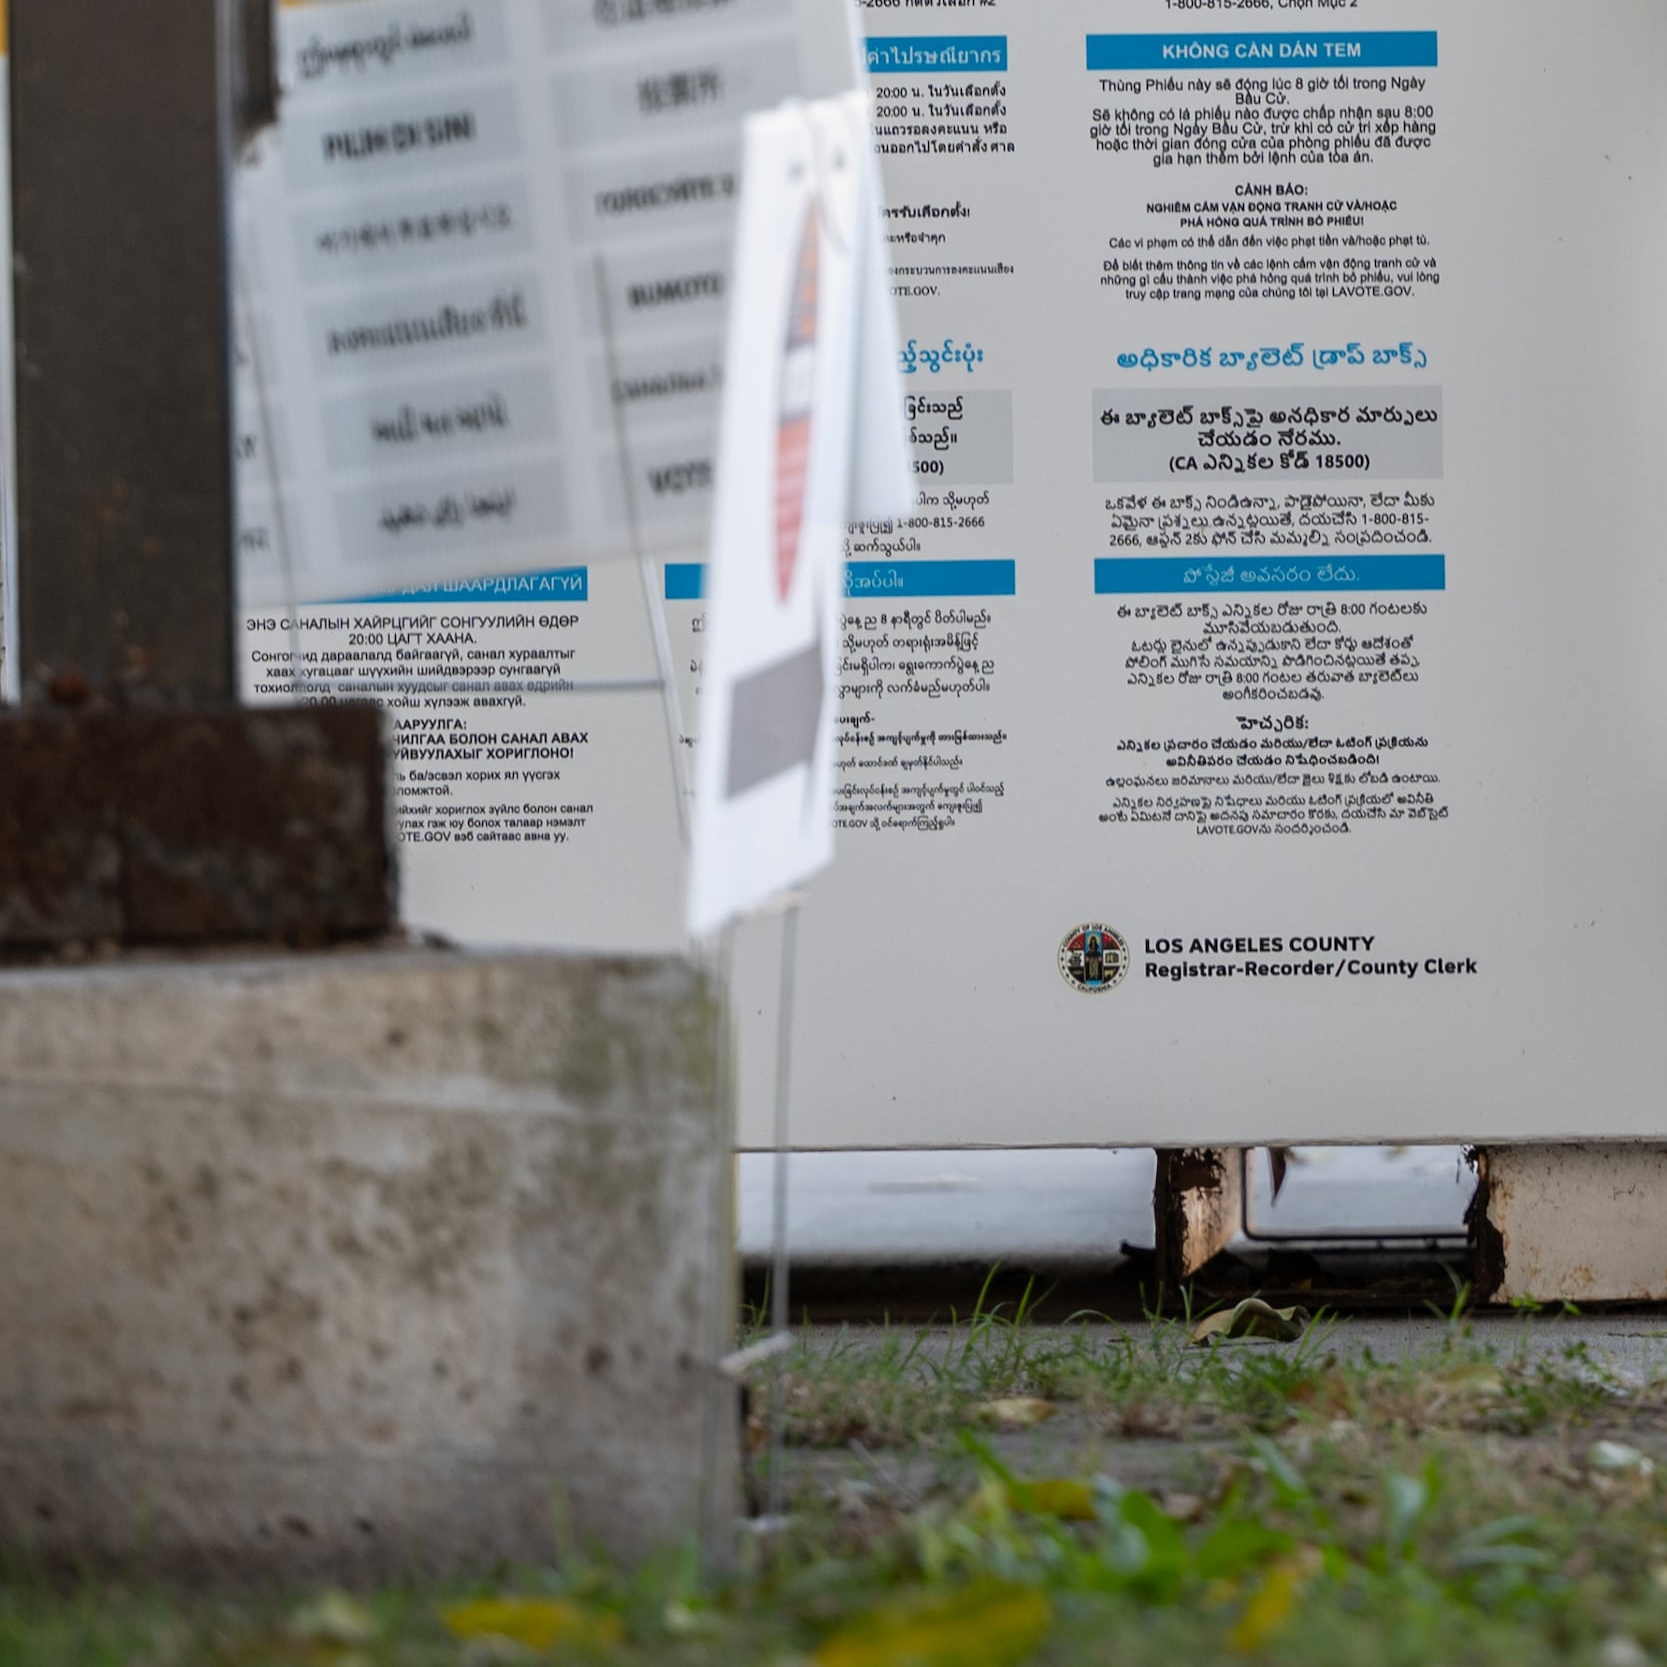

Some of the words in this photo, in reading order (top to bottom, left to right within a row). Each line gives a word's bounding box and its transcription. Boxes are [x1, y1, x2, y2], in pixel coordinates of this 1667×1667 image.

[1162, 40, 1231, 59] KHÔNG
[1323, 41, 1362, 57] TEM
[348, 632, 385, 646] 20:00
[387, 630, 424, 648] ЦАГТ
[426, 631, 478, 645] ХААНА.
[1145, 937, 1185, 954] LOS
[1189, 936, 1285, 954] ANGELES
[1289, 935, 1376, 952] COUNTY
[1145, 958, 1420, 982] Registrar-Recorder/County
[1424, 956, 1478, 974] Clerk
